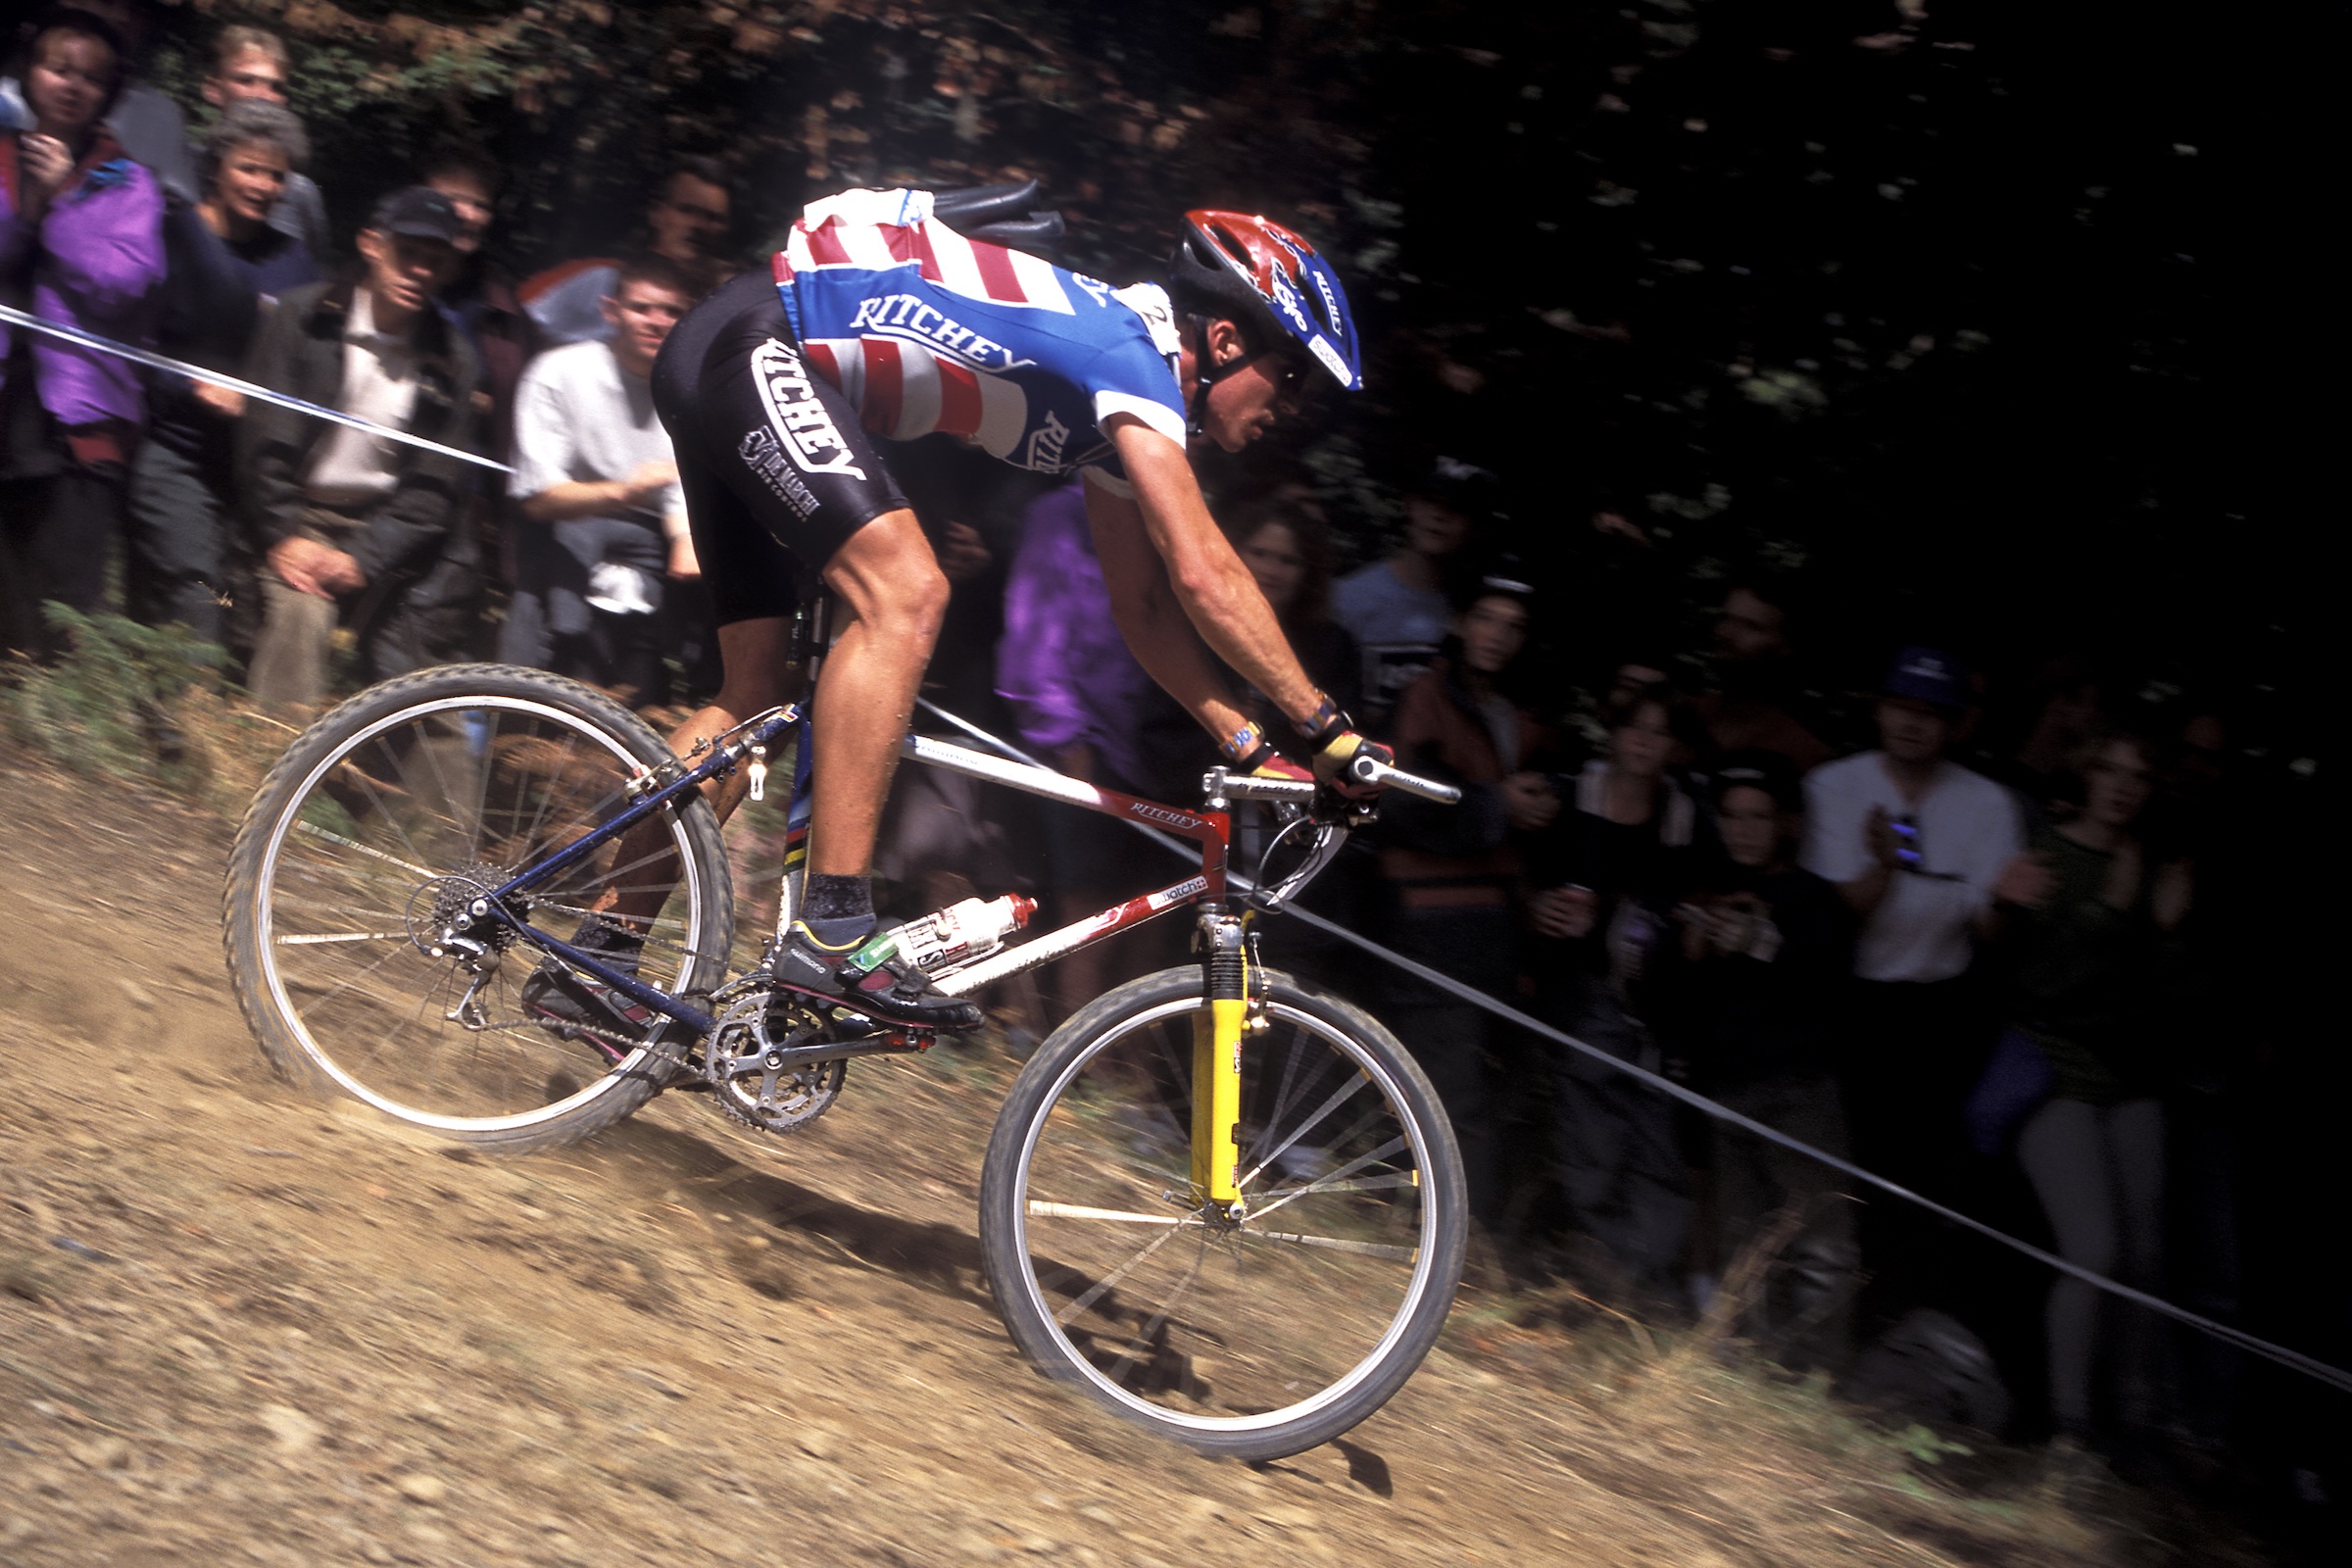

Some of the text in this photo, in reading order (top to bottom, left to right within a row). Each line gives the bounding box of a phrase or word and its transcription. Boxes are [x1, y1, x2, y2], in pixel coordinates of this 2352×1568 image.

[1141, 305, 1168, 326] 2
[849, 294, 1038, 373] RITCHEY
[1130, 803, 1203, 829] RITCHEY
